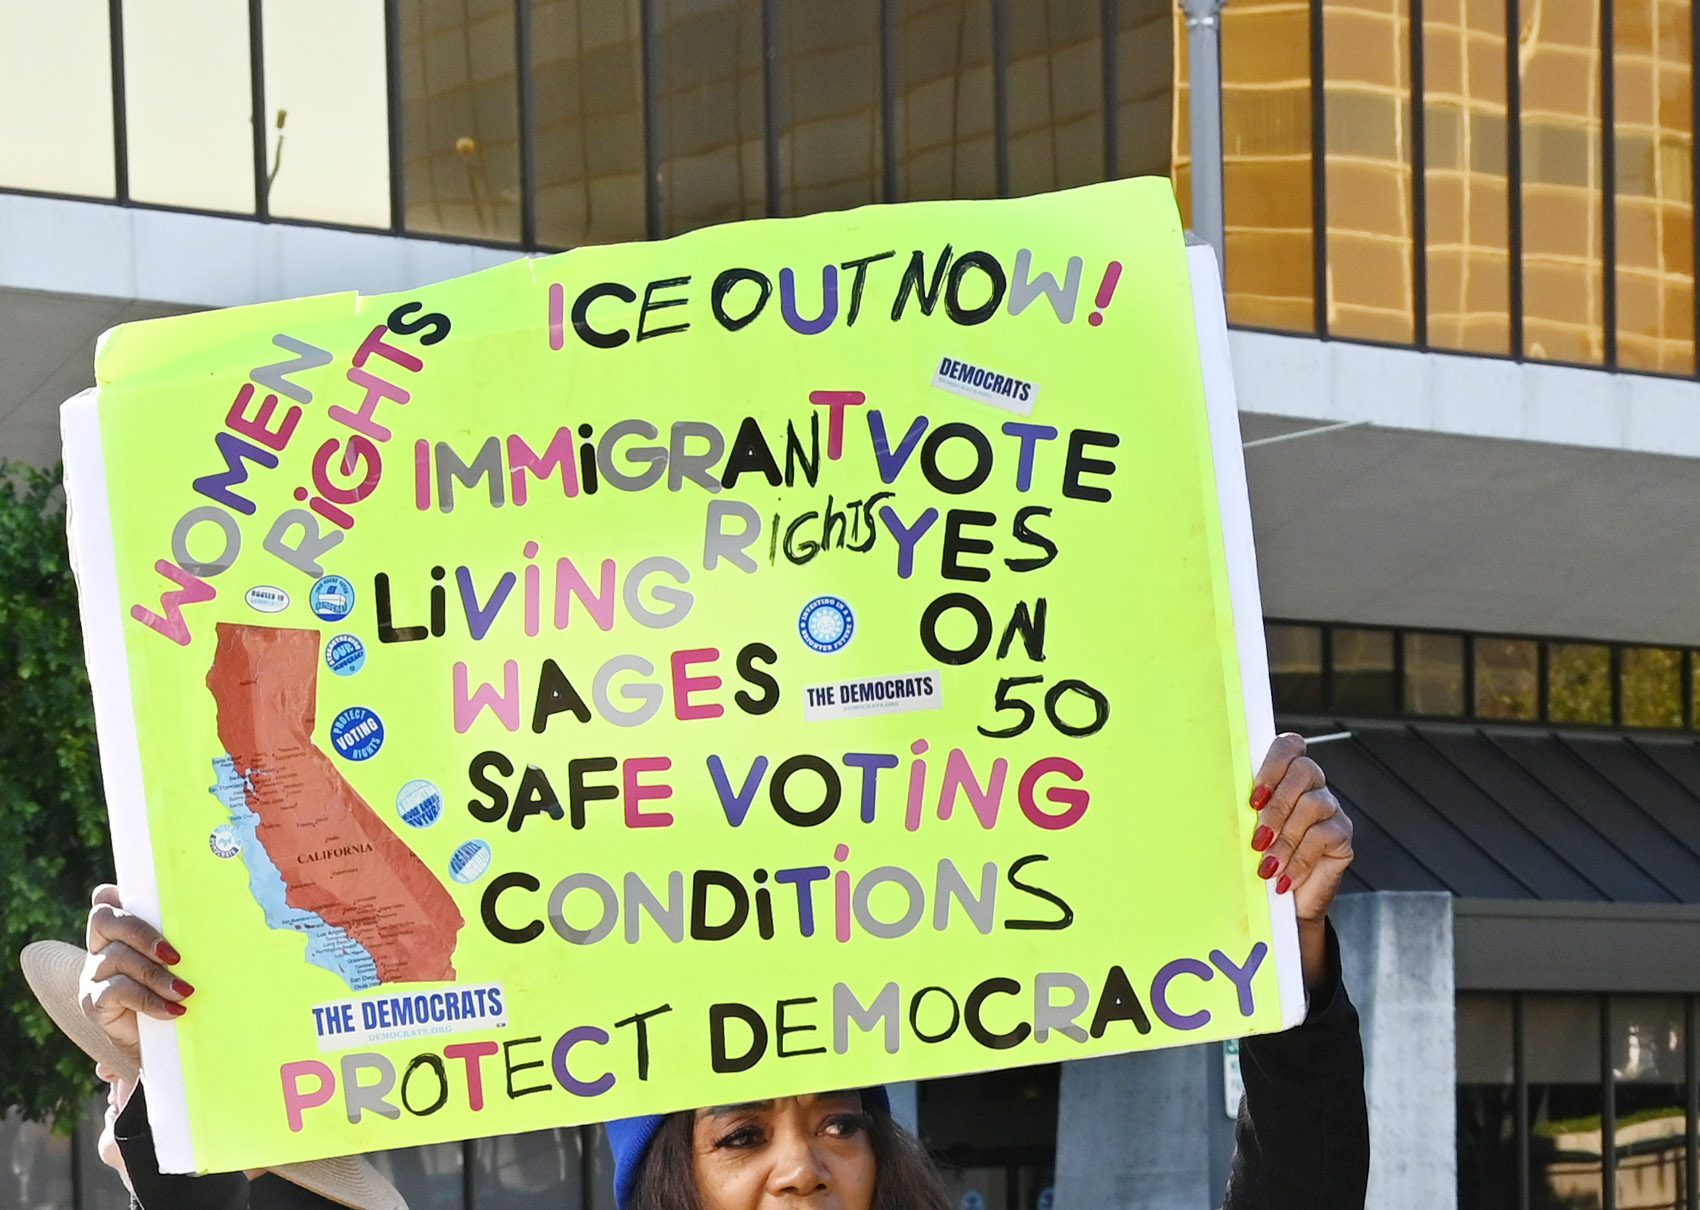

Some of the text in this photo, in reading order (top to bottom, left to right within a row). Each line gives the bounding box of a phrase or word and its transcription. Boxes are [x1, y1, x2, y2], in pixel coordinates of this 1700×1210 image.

[549, 244, 1123, 350] ICE OUT NOW!
[939, 357, 1032, 401] DEMOCRATS
[866, 410, 1121, 503] VOTE
[130, 333, 334, 646] WOMEN
[879, 505, 1058, 582] YES
[919, 591, 1047, 665] ON
[452, 643, 780, 733] WAGES
[807, 676, 933, 708] THE DEMOCRATS
[977, 675, 1110, 739] 50
[333, 709, 366, 734] PROTECT
[336, 717, 379, 750] VOTING
[352, 737, 381, 759] RIGHTS
[467, 750, 674, 832] SAFE
[297, 843, 374, 865] CALIFORNIA
[280, 941, 1268, 1133] PROTECT DEMOCRACY
[312, 988, 503, 1036] THE DEMOCRATS
[368, 1025, 452, 1042] DEMOCRATS.ORG
